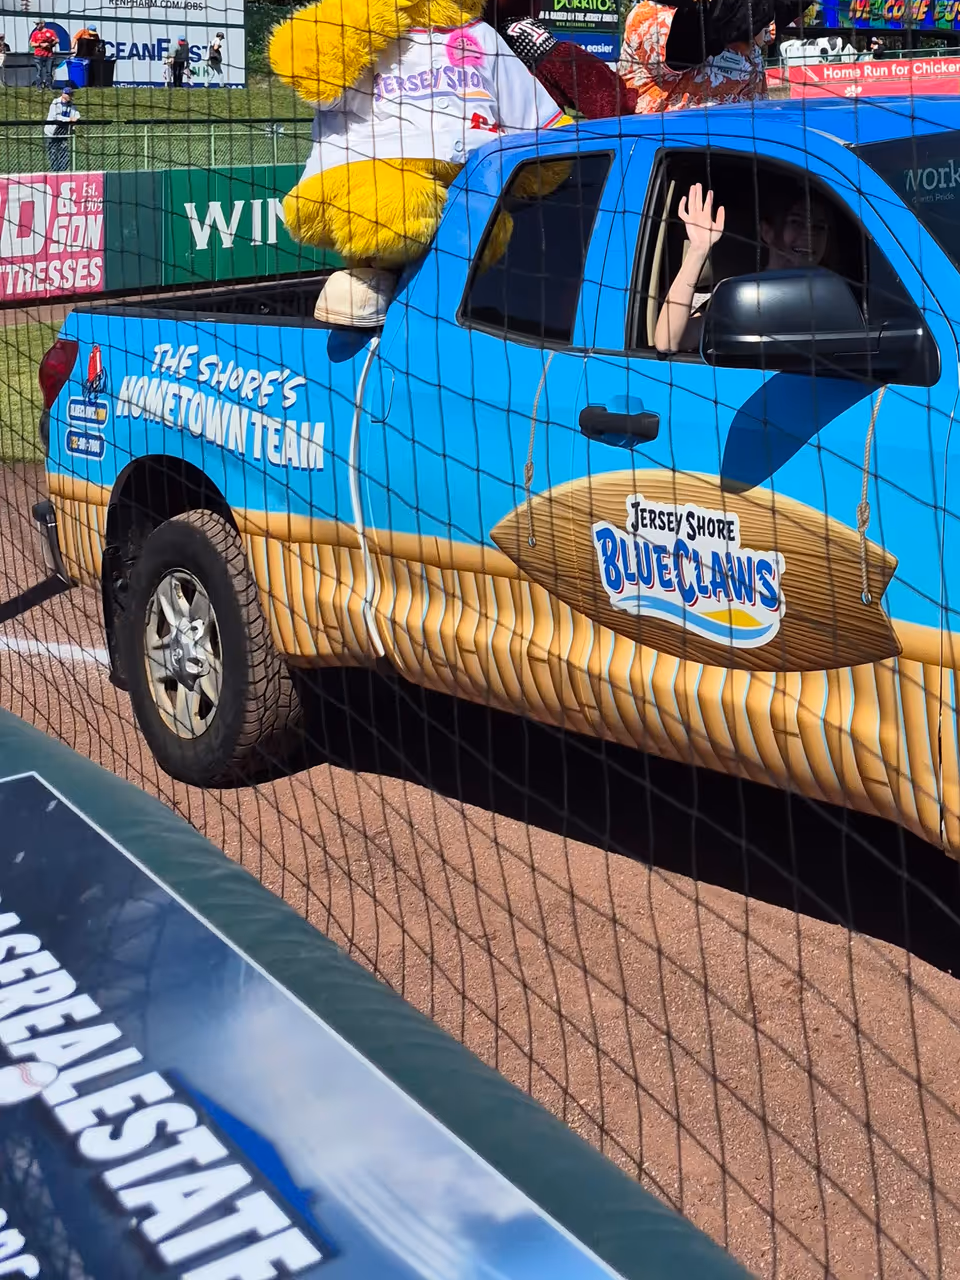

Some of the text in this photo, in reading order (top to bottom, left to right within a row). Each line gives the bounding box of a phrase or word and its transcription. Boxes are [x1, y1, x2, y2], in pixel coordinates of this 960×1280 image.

[587, 43, 614, 53] easier
[373, 65, 485, 103] JERSEY SHO
[823, 67, 861, 79] Home
[864, 65, 888, 77] Run
[892, 64, 909, 75] for
[57, 182, 78, 215] &
[81, 198, 103, 213] 1909
[82, 182, 99, 197] Est.
[49, 215, 104, 254] SON
[0, 257, 103, 295] TRESSES
[151, 343, 307, 408] THE SHORE'S
[116, 375, 325, 472] HOMETOWN TEAM
[631, 501, 736, 541] JERSEY SHORE
[595, 527, 780, 612] BLUECLAWS
[0, 912, 323, 1280] SEREALESTATE
